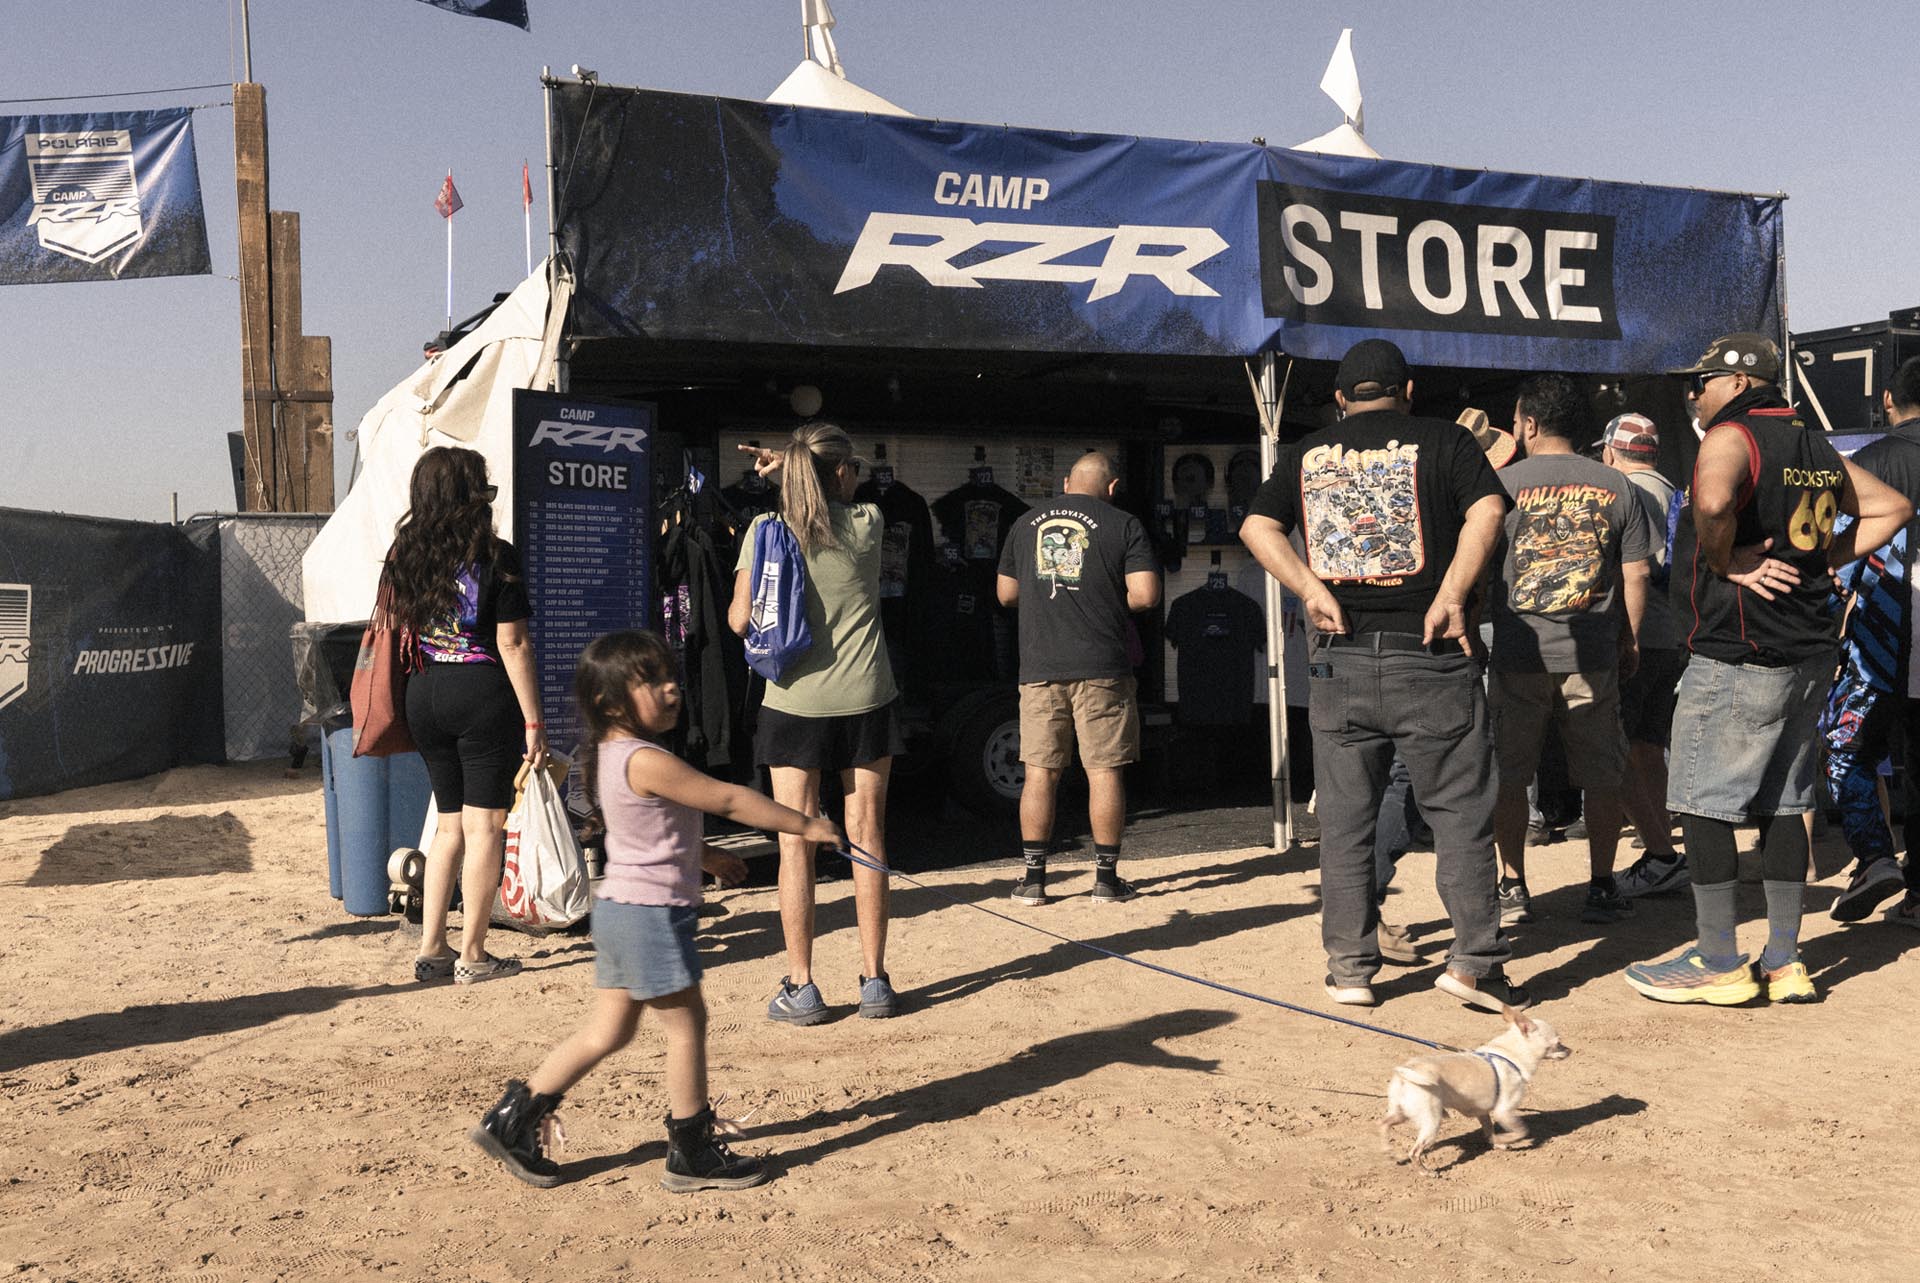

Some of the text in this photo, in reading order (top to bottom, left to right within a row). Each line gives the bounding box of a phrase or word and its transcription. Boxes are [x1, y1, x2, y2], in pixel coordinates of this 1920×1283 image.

[37, 136, 119, 149] POLARIS
[52, 190, 88, 202] CAMP
[934, 171, 1050, 210] CAMP
[26, 198, 141, 227] RZR
[833, 212, 1230, 303] RZR
[1280, 203, 1602, 323] STORE
[560, 407, 595, 422] CAMP
[528, 420, 648, 453] RZR
[1302, 439, 1420, 472] Glamis
[549, 461, 627, 490] STORE
[1031, 513, 1048, 526] THE
[73, 642, 194, 675] PROGRESSIVE
[434, 651, 465, 663] 2025
